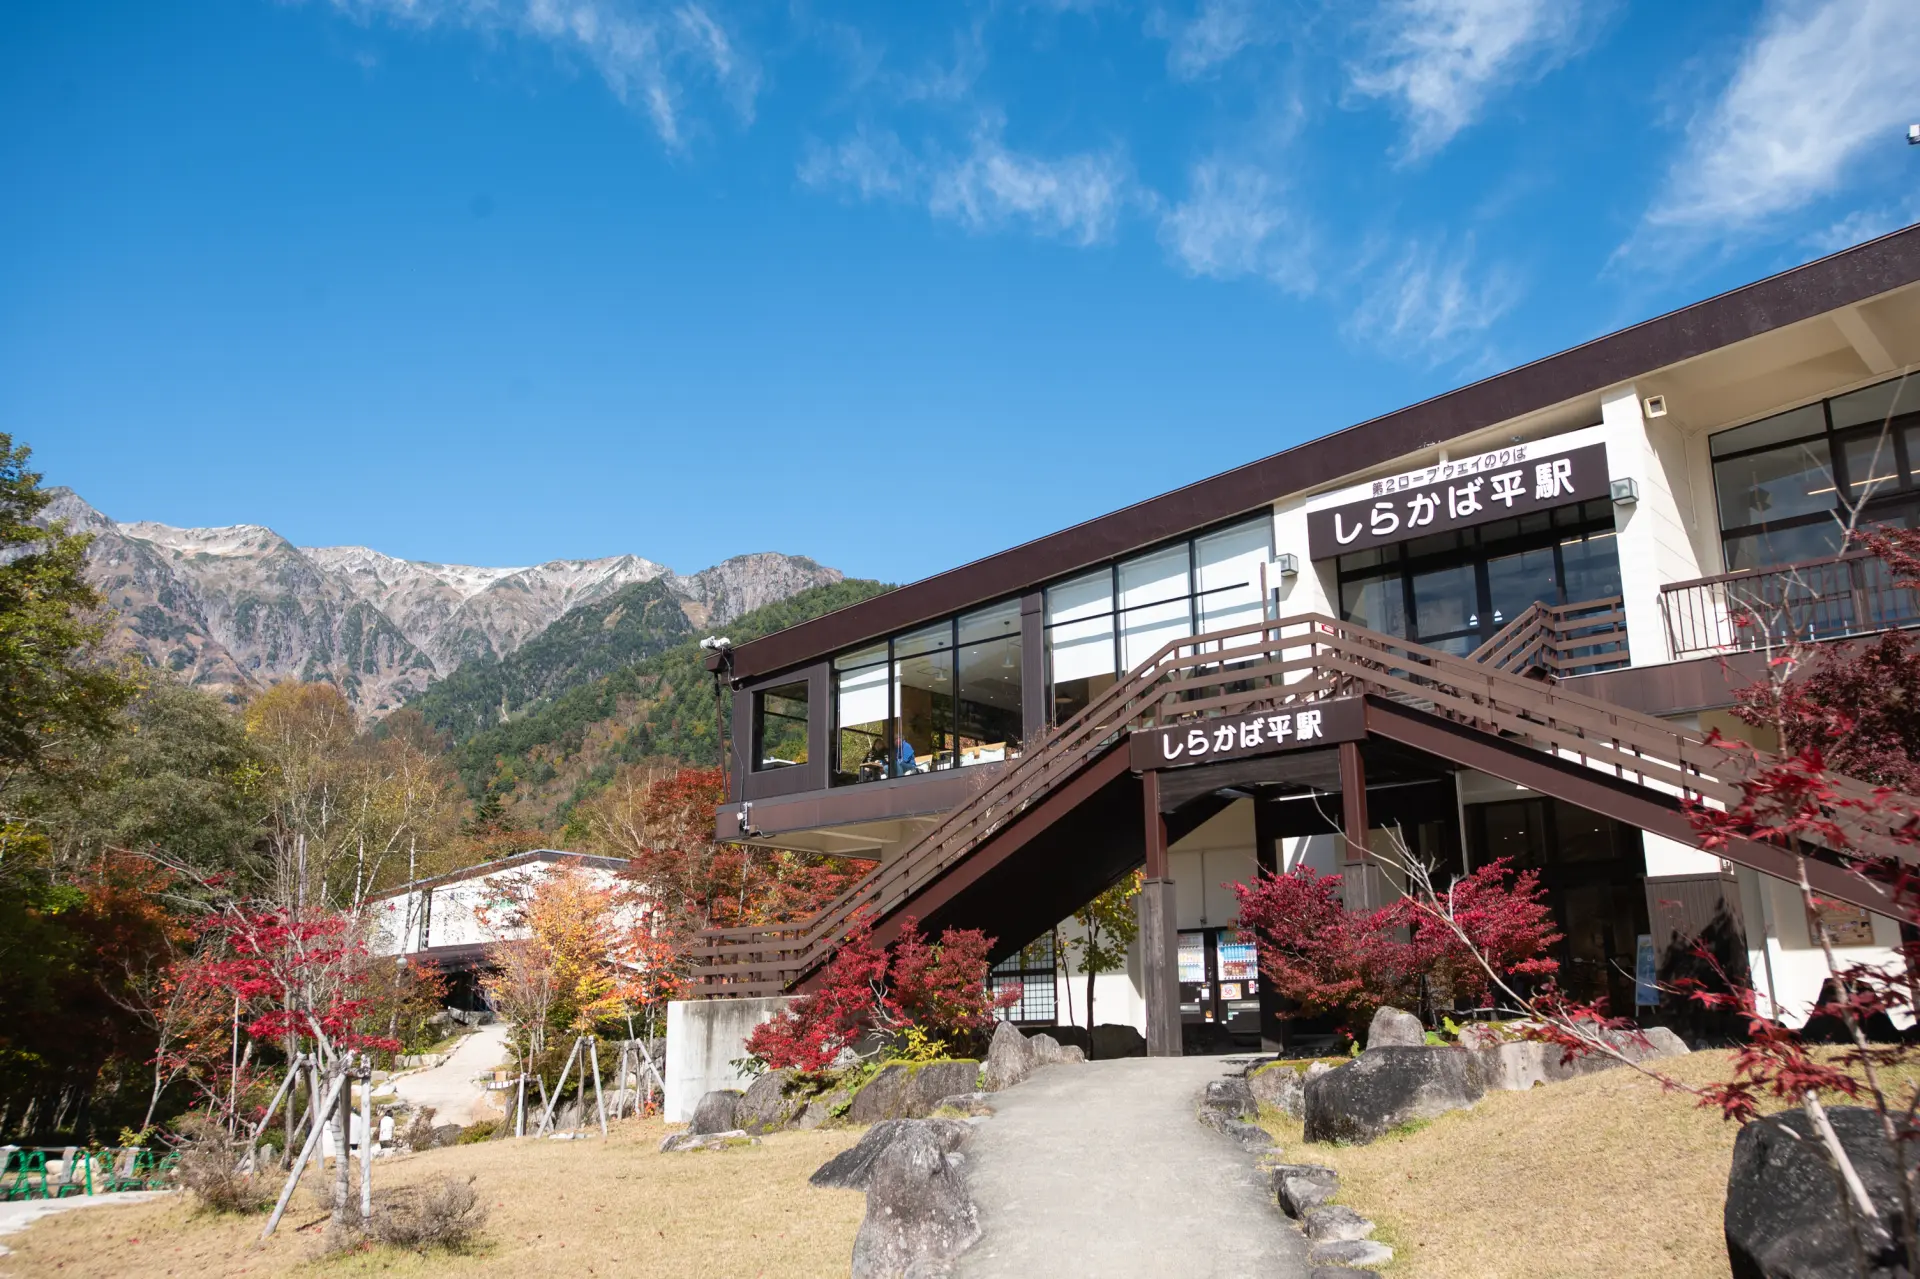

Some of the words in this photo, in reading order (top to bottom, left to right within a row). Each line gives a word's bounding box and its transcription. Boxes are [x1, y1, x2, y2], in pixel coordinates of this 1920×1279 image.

[1334, 458, 1575, 544] しらかば平駅
[1163, 709, 1323, 760] しらかば平駅
